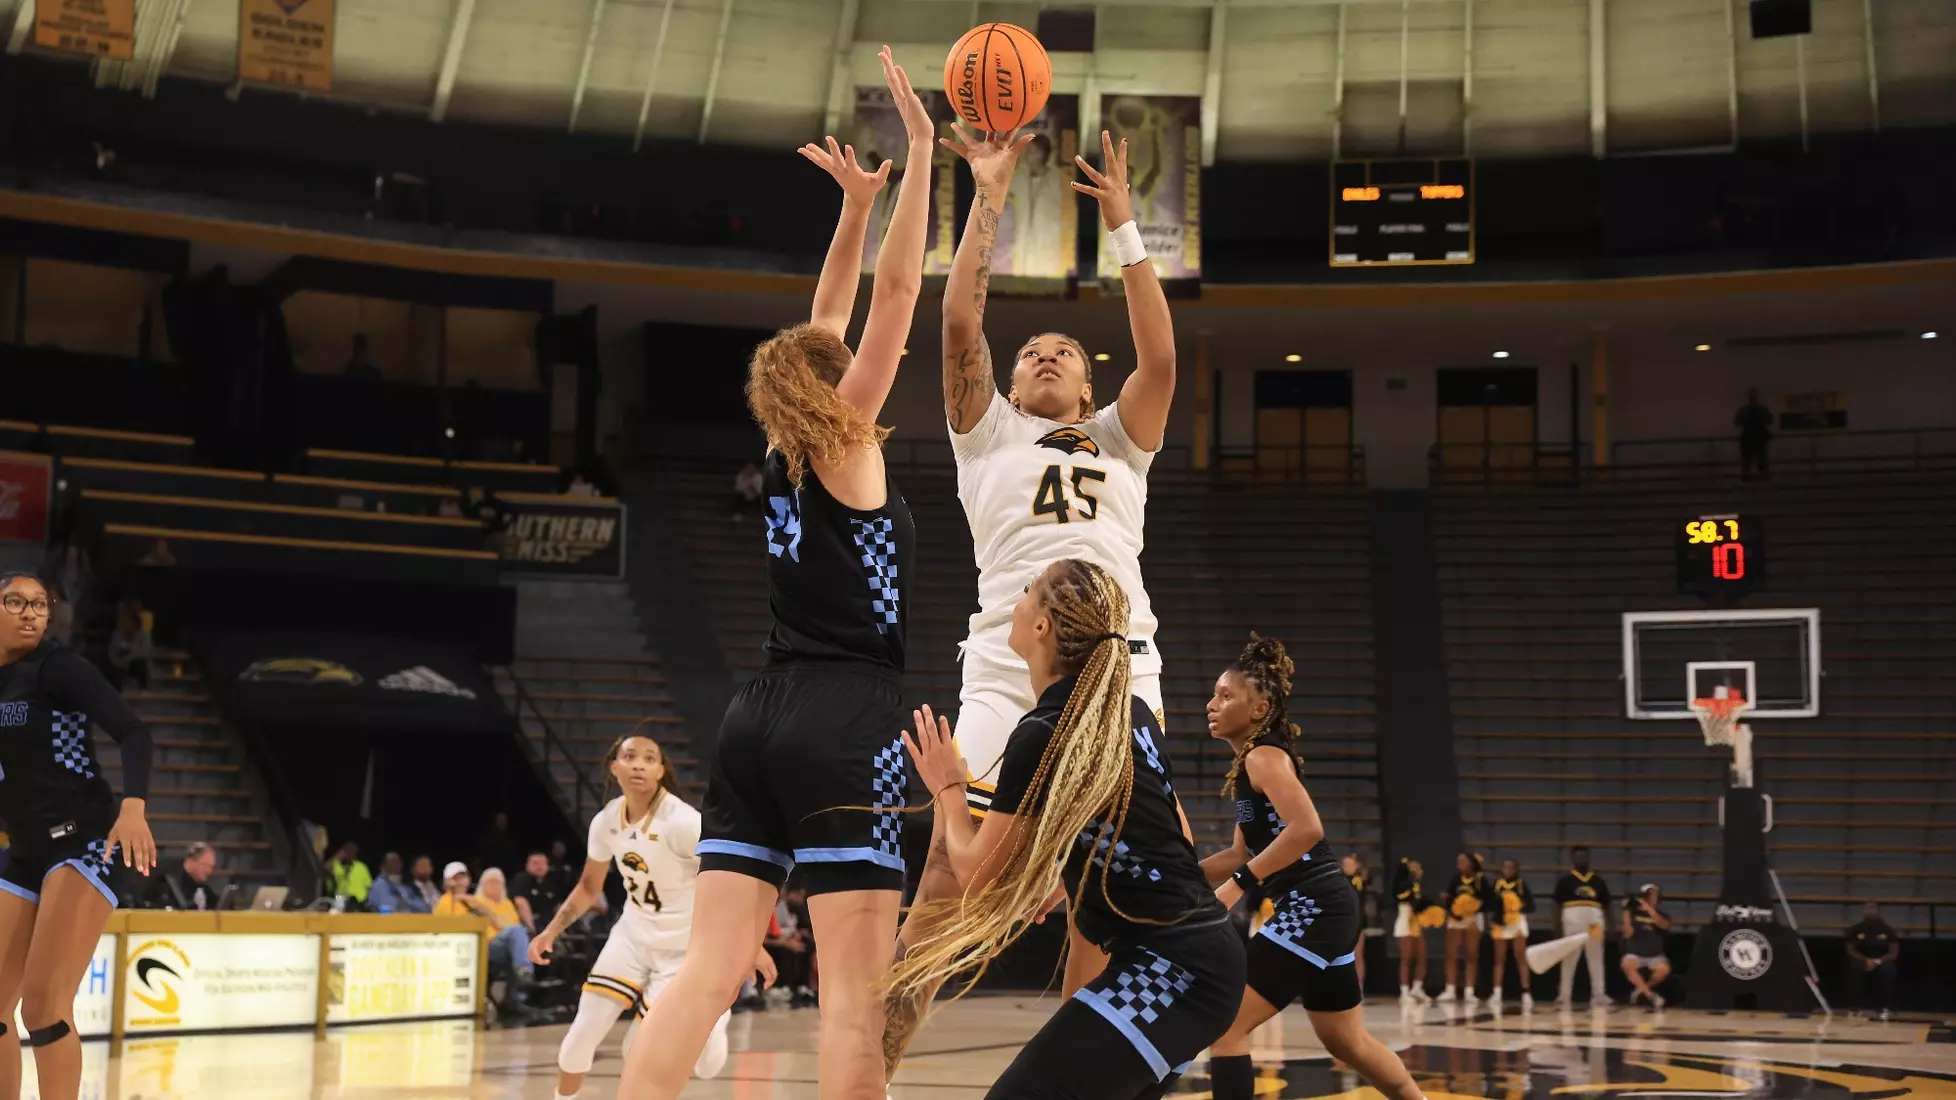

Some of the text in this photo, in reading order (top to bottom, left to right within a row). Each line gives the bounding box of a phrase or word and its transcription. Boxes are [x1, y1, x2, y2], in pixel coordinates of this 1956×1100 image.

[957, 51, 981, 123] Wilson
[1033, 464, 1107, 524] 45
[1686, 520, 1739, 544] 58.7
[518, 540, 569, 562] MISS
[1713, 543, 1745, 579] 10
